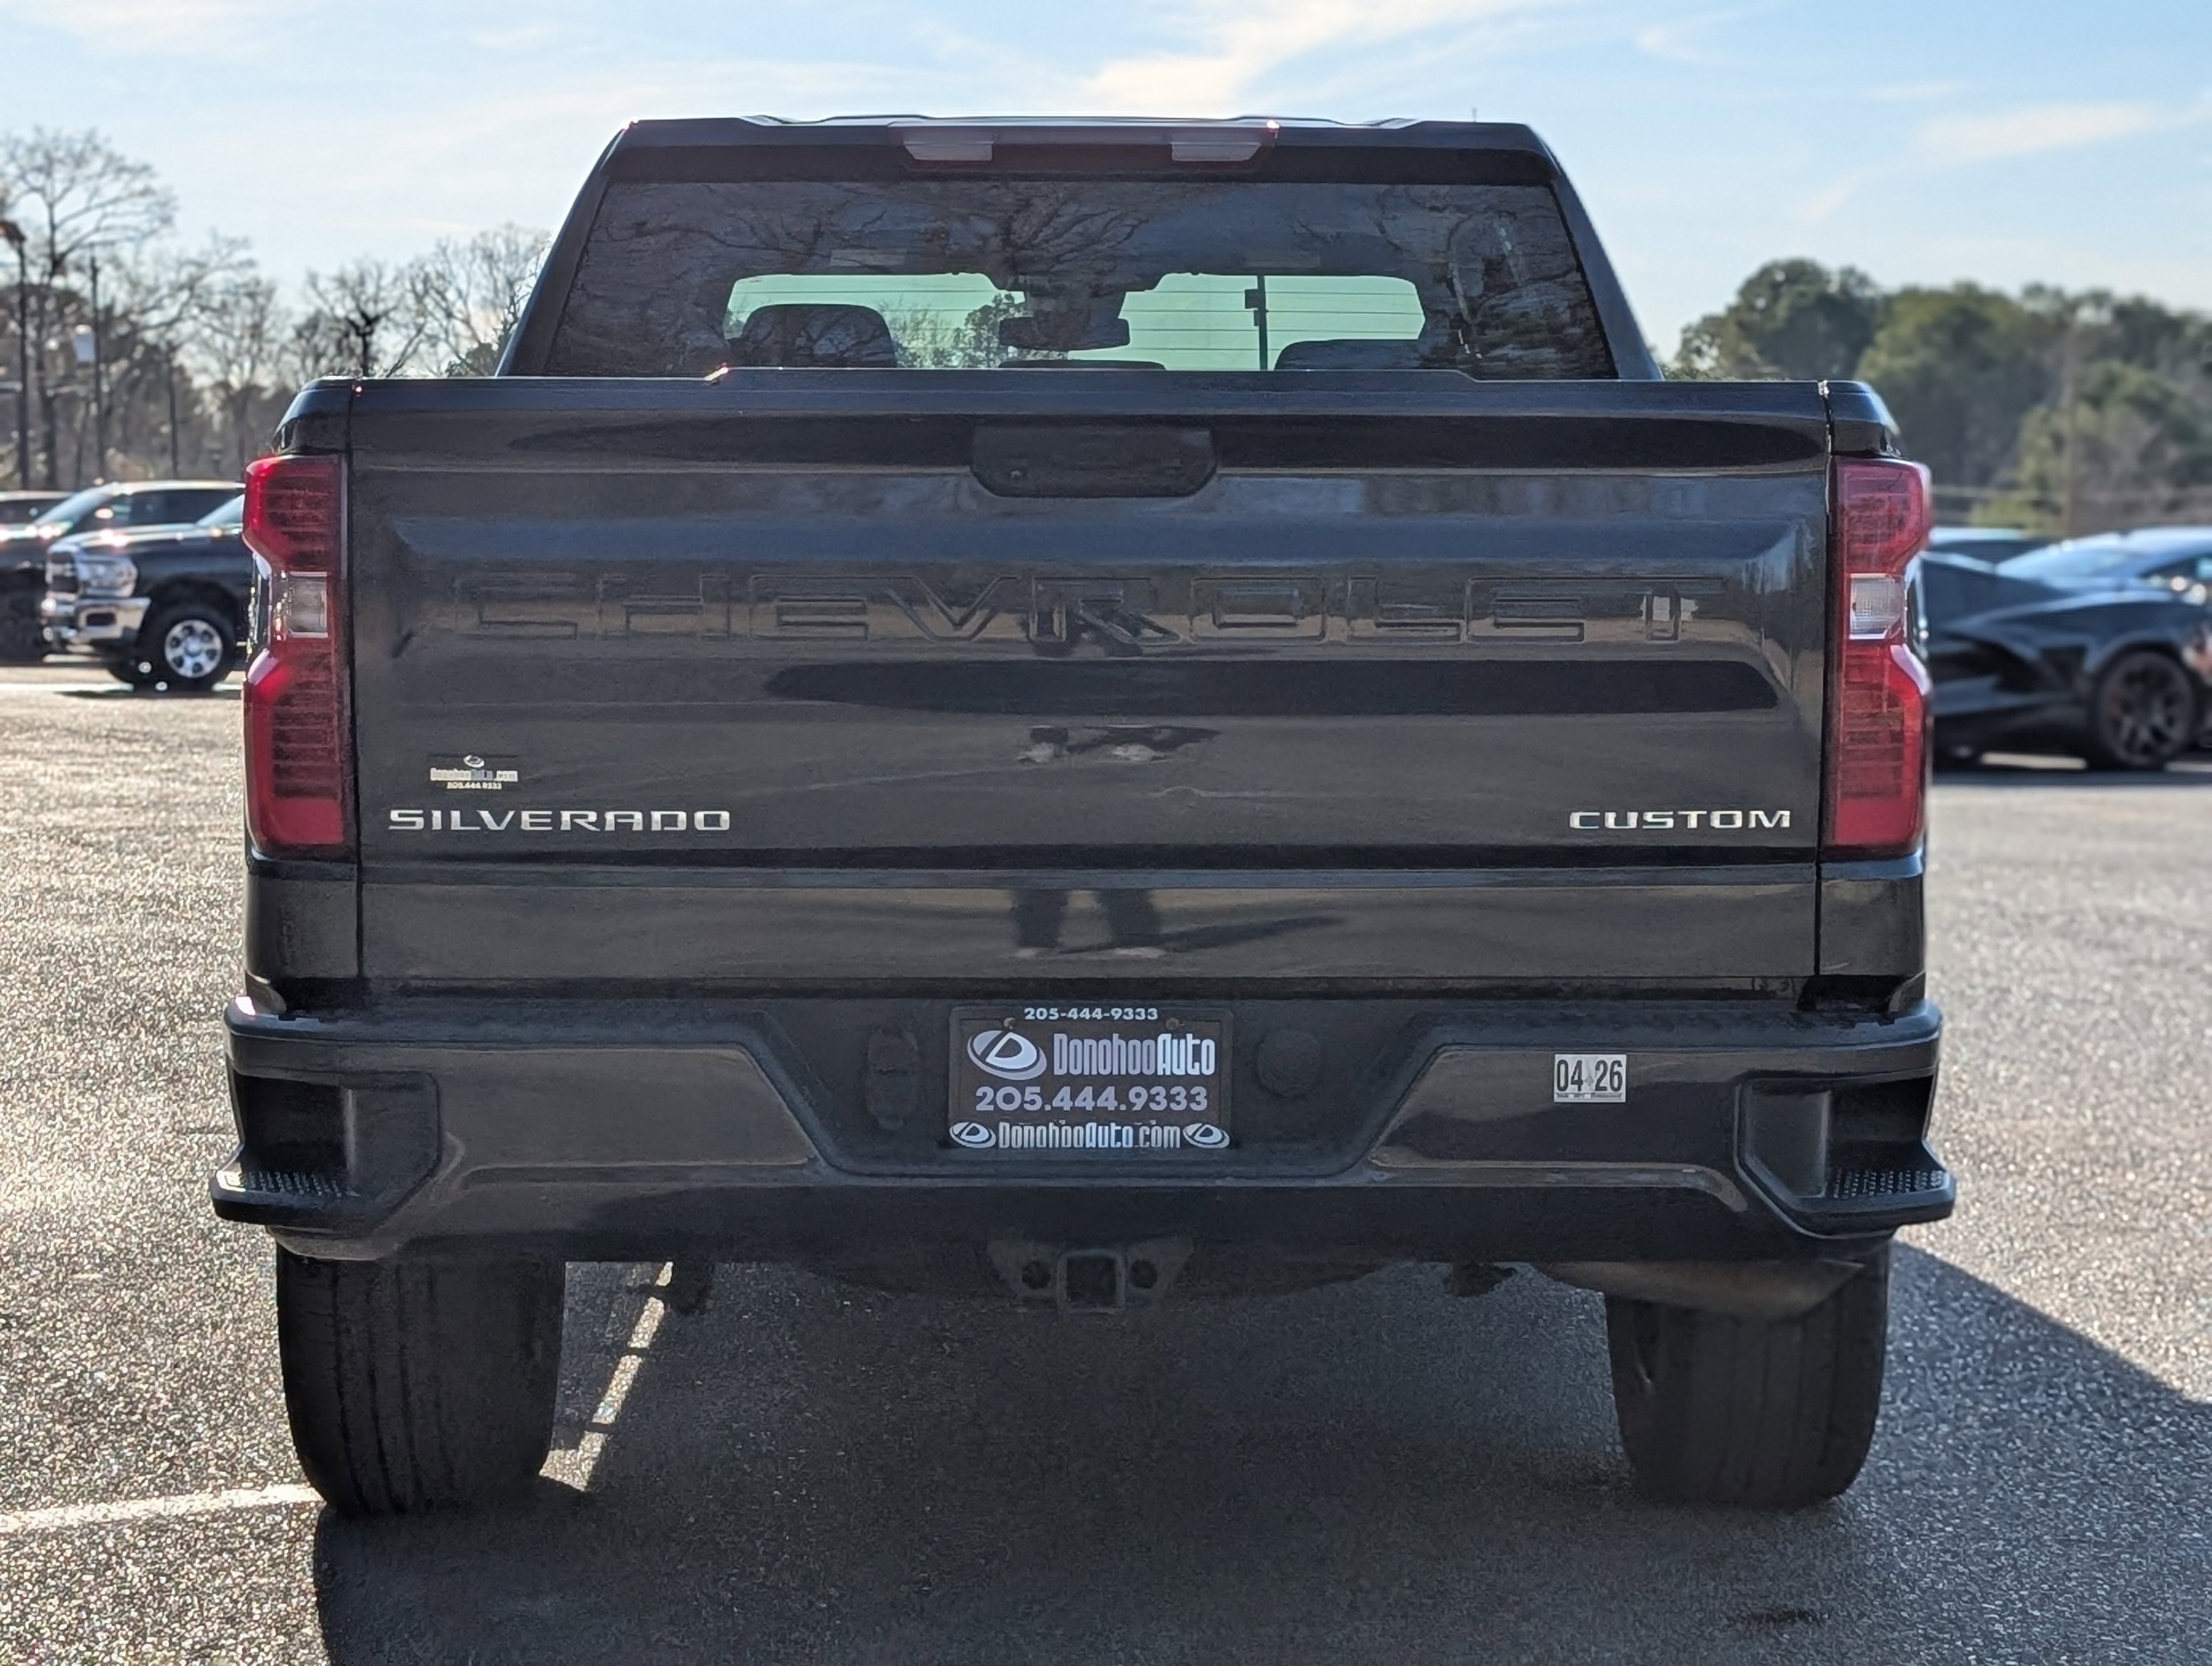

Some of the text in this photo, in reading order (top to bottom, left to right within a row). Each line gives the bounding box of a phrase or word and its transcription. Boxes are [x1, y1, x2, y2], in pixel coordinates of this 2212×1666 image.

[388, 810, 730, 832] SILVERADO
[1569, 810, 1791, 829] CUSTOM
[1024, 1007, 1159, 1021] 205-444-9333
[1053, 1033, 1216, 1075] DonohooAuto
[1557, 1059, 1623, 1092] 04 26
[975, 1086, 1208, 1111] 205.444.9333
[998, 1122, 1180, 1148] DonohooAuto.com
